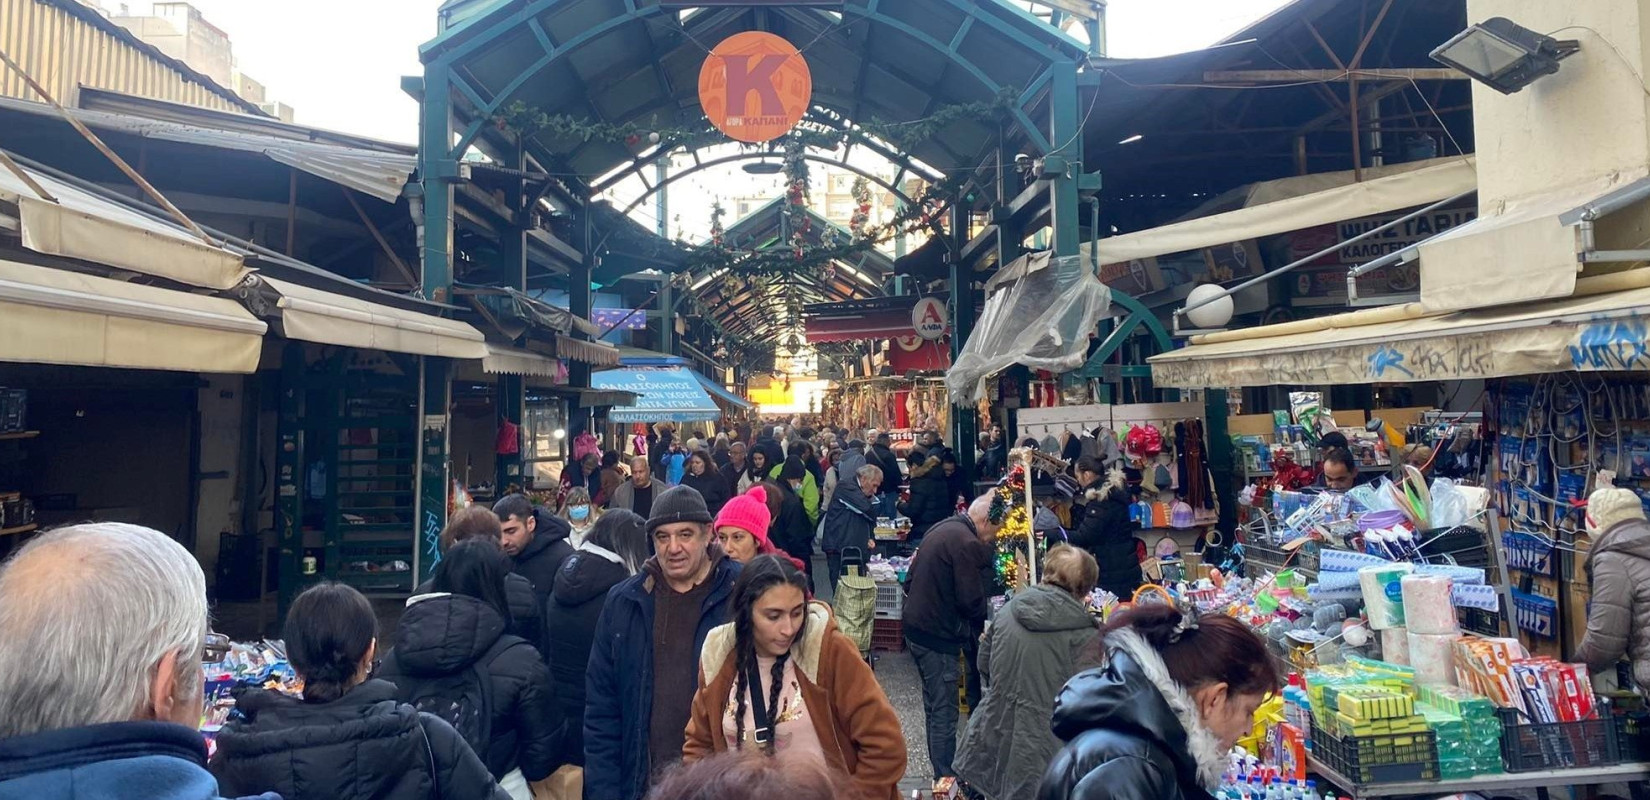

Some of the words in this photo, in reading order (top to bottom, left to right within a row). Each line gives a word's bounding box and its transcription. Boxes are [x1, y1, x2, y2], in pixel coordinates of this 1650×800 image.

[743, 117, 788, 126] ΚΑΠΑΝΙ
[666, 391, 702, 399] ΙΧΘΕΙΣ
[614, 413, 674, 422] ΘΑΛΑΣΣΟΚΗΠΟΣ
